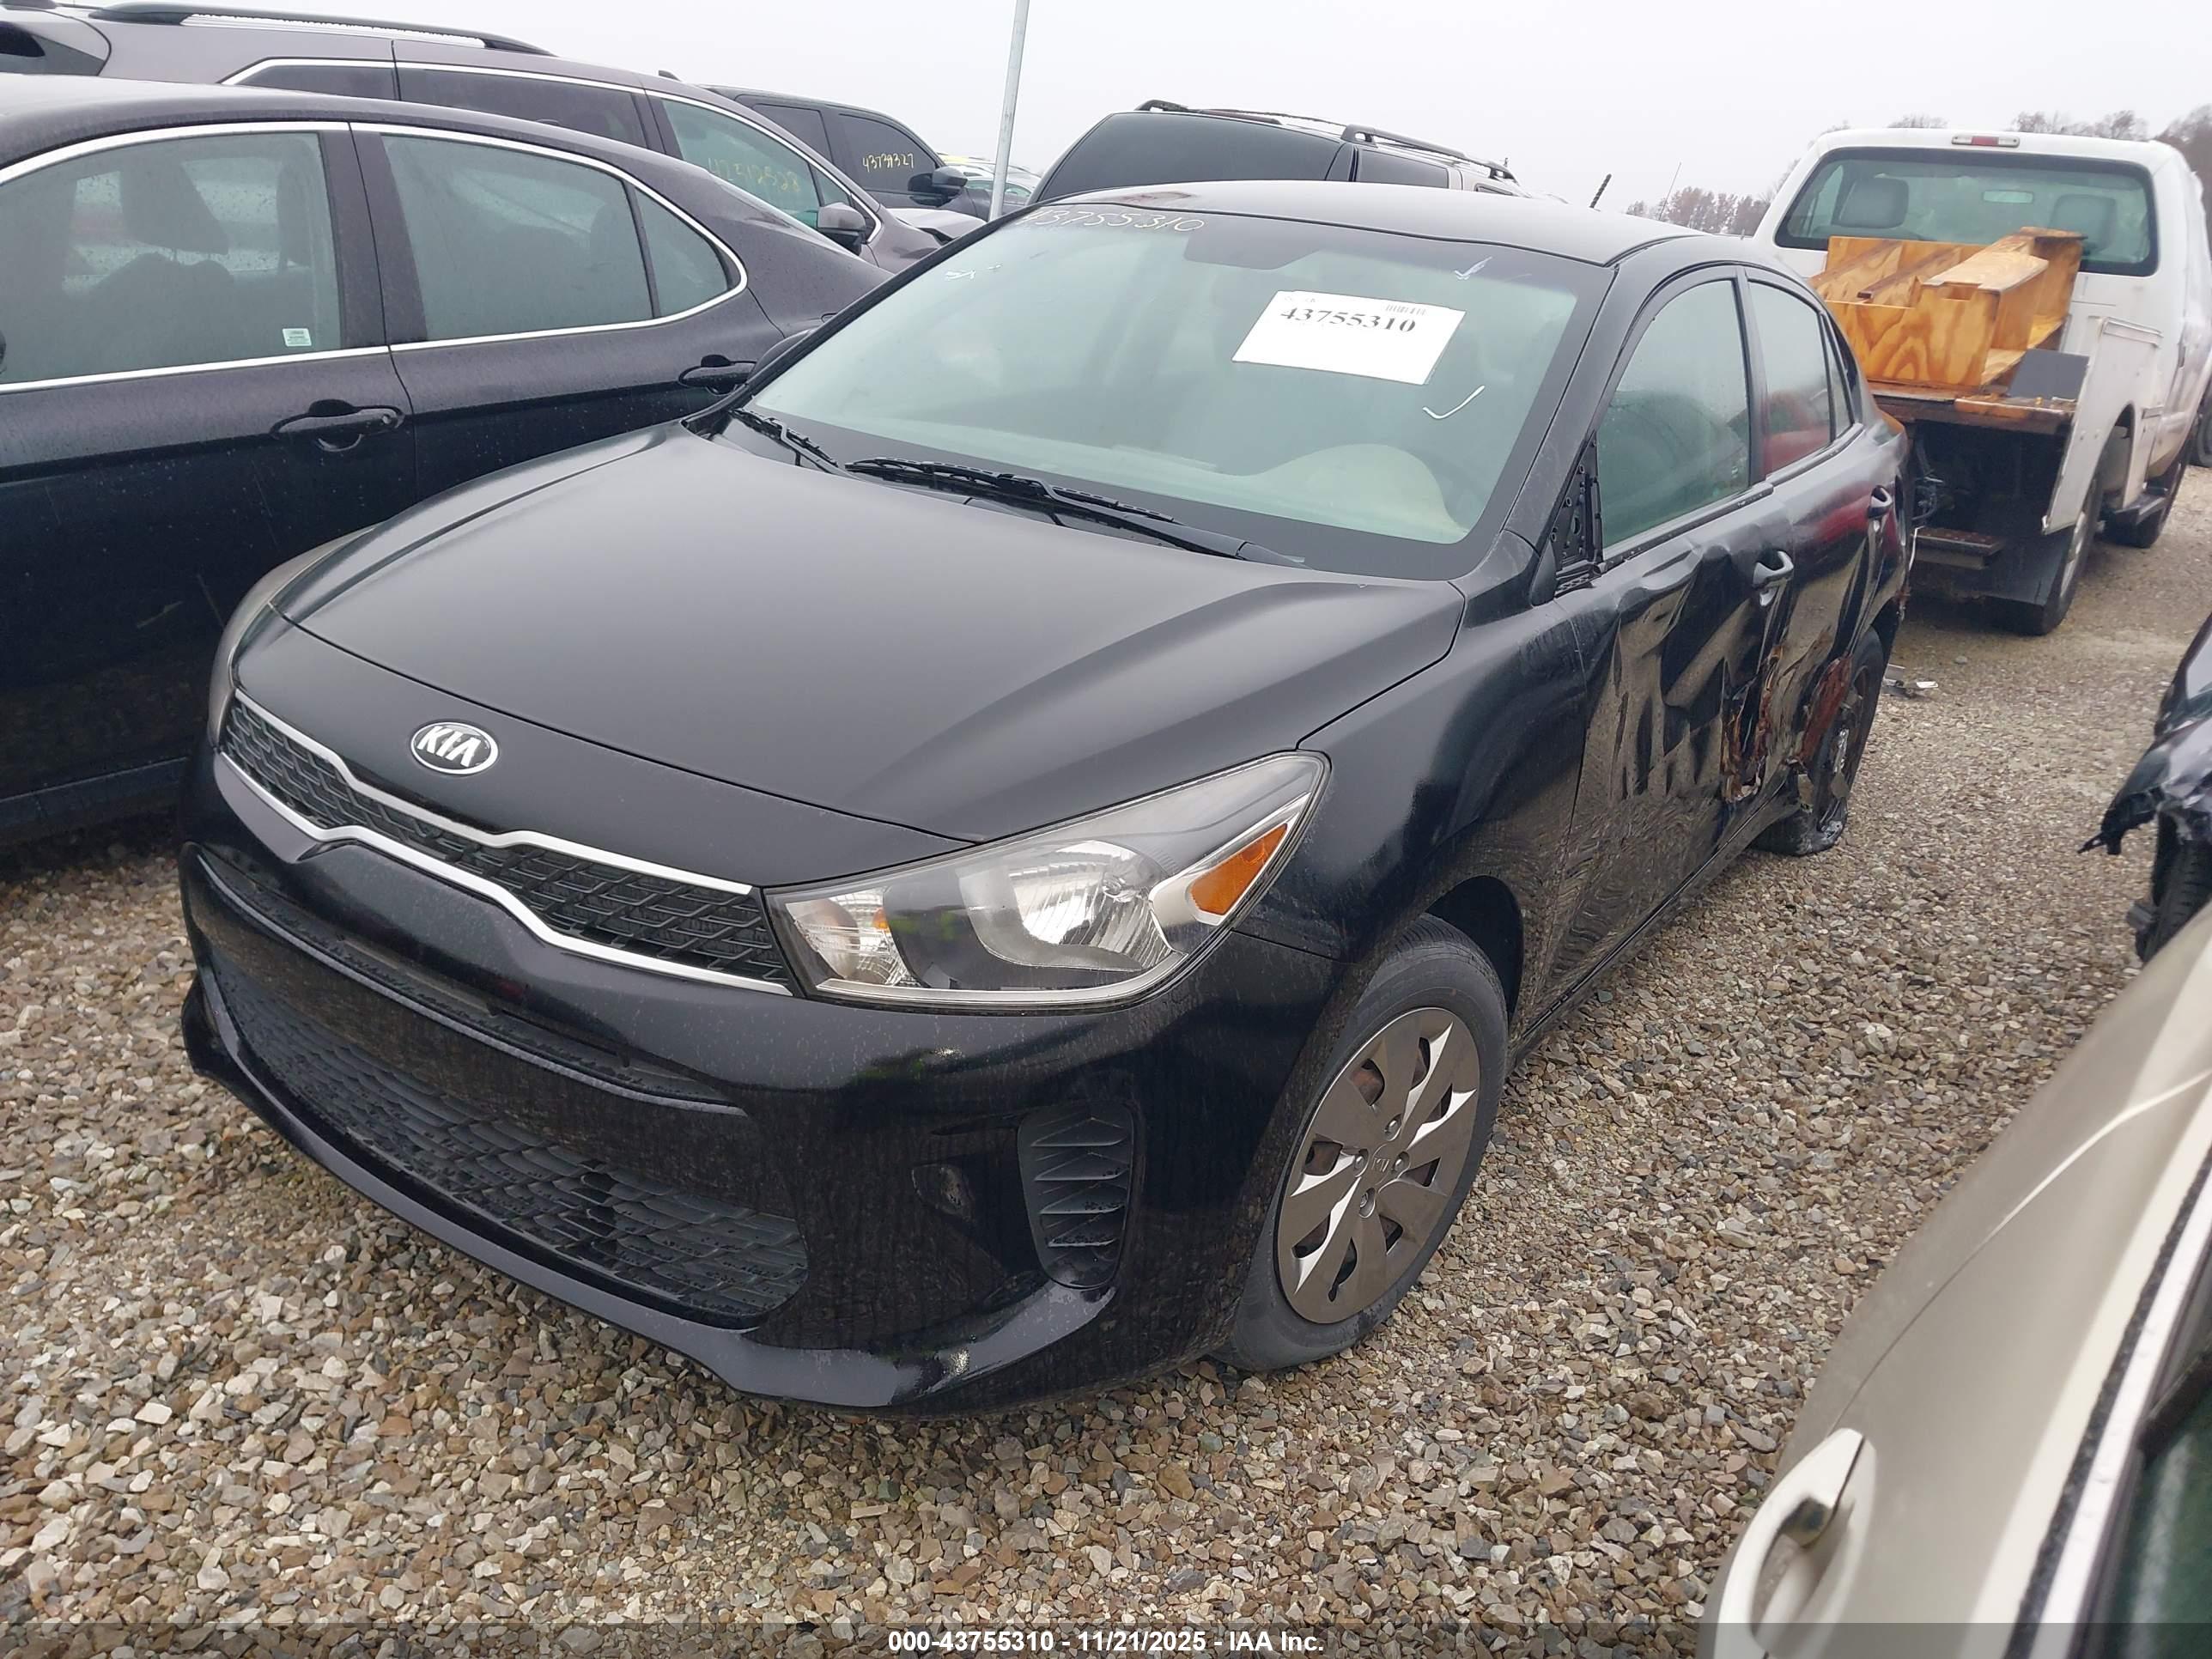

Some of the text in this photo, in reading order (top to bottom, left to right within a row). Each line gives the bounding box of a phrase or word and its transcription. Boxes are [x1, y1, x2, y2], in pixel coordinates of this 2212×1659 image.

[862, 153, 915, 173] 43739327
[1016, 209, 1205, 232] 43755310
[1279, 306, 1417, 333] 43755310
[416, 726, 482, 768] KIA
